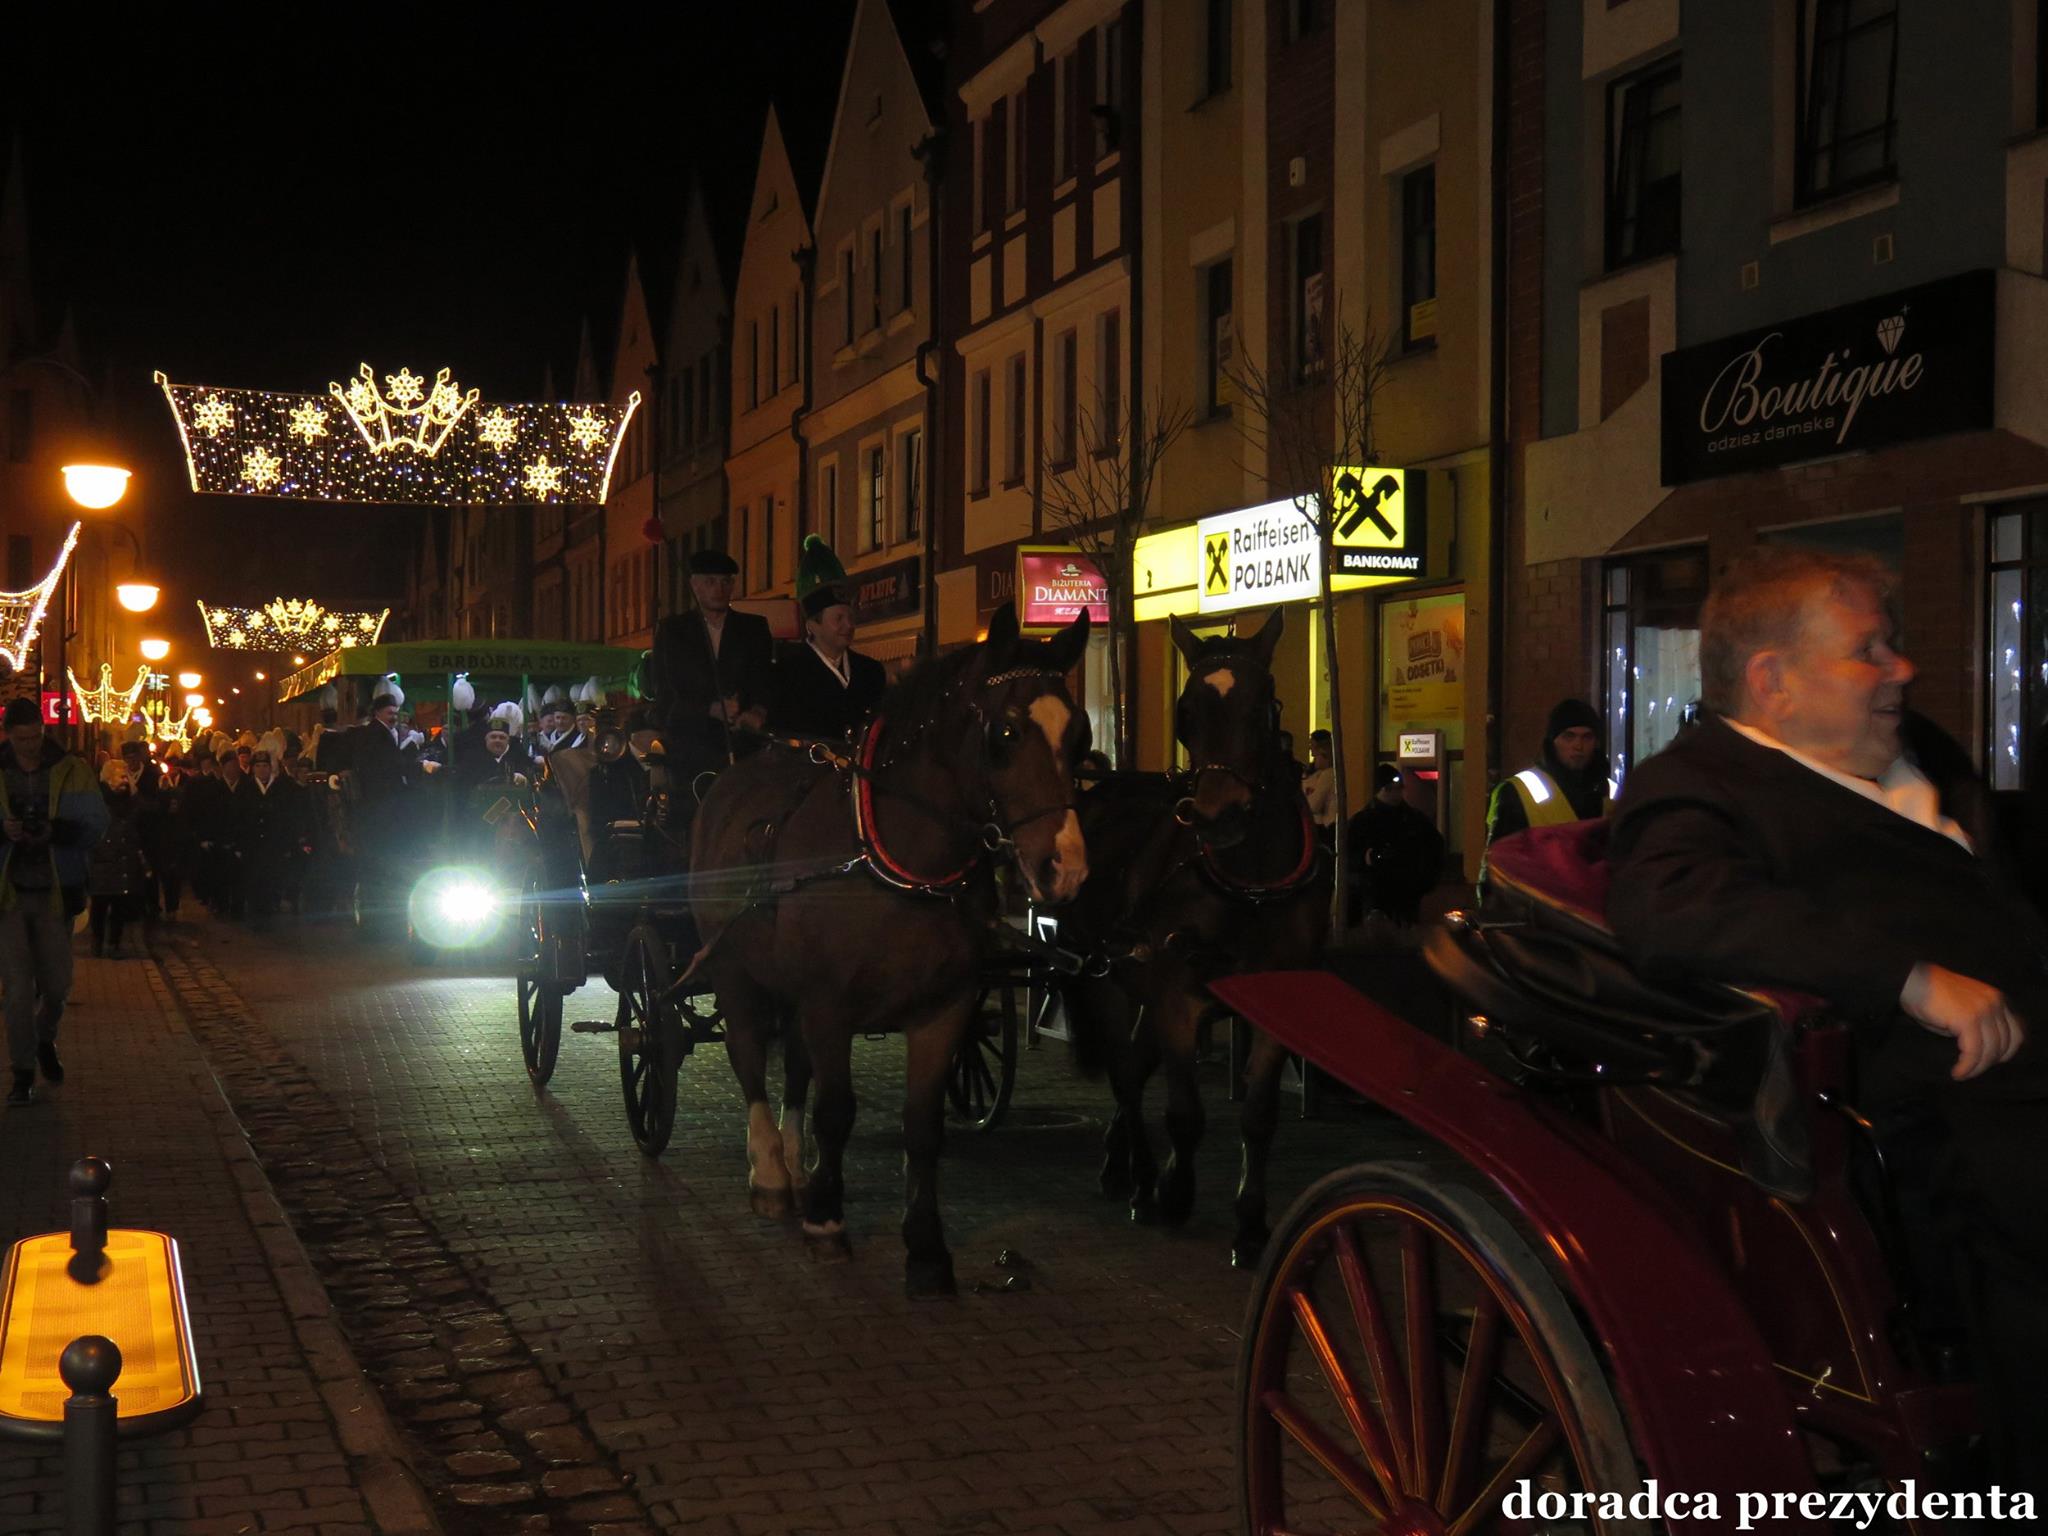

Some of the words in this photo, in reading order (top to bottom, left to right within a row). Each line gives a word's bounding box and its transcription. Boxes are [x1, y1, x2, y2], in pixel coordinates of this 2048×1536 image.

[1701, 332, 1925, 447] Boutique
[1764, 415, 1836, 441] damska
[1233, 517, 1310, 555] Raiffeisen
[1234, 553, 1311, 591] POLBANK
[1343, 555, 1420, 570] BANKOMAT
[1034, 586, 1108, 602] DIAMANT
[540, 656, 582, 671] 2015
